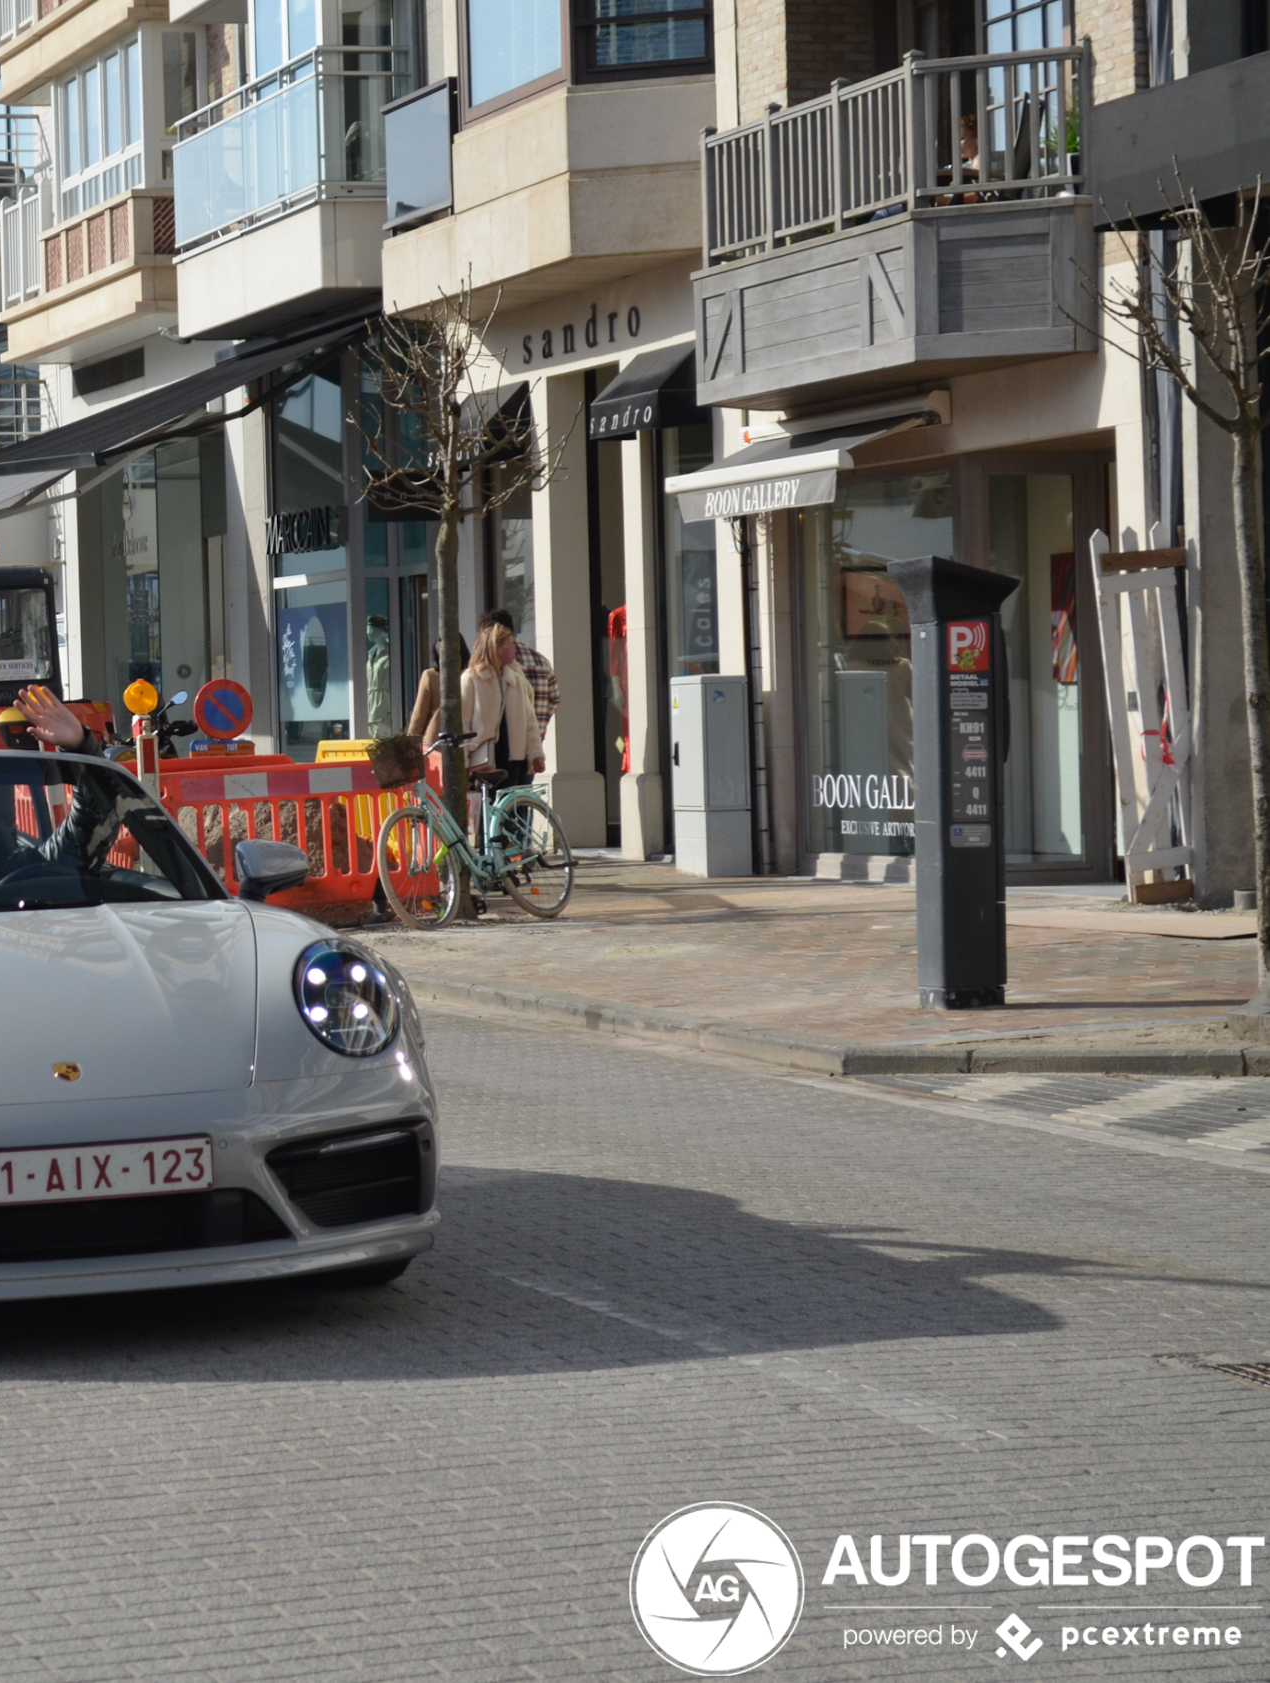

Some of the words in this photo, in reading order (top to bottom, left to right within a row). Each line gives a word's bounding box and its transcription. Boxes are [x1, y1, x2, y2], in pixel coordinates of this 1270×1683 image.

[522, 303, 641, 364] sandro
[590, 405, 653, 434] sandro
[704, 487, 740, 518] BOON
[742, 478, 800, 513] GALLERY
[950, 626, 974, 665] P
[959, 722, 985, 734] KH91
[226, 743, 238, 751] TOT
[965, 766, 986, 778] 4411
[811, 774, 862, 809] BOON
[972, 787, 980, 799] Q
[966, 804, 987, 815] 4411
[841, 819, 880, 836] EXCLUSIVE
[0, 1147, 205, 1194] 1-AIX-123
